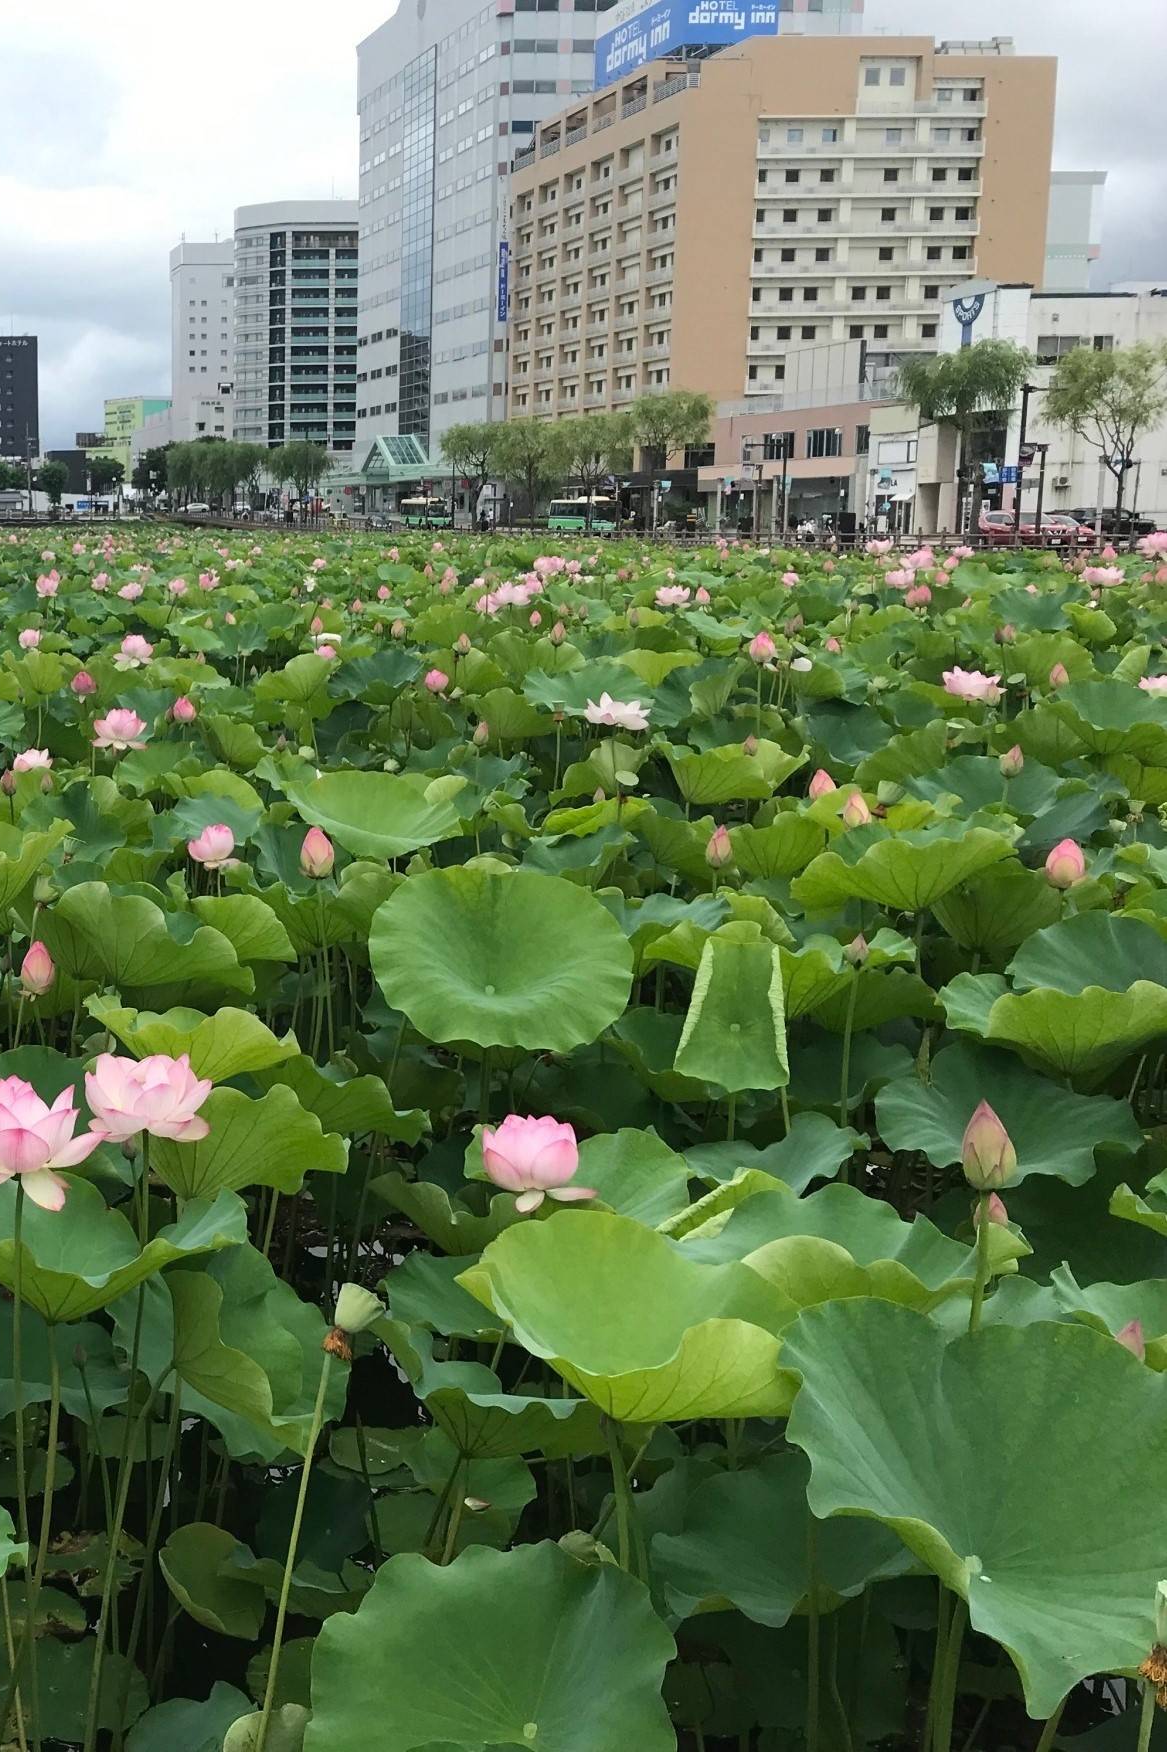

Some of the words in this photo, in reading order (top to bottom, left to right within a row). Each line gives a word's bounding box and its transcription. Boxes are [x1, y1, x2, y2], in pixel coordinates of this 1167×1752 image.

[701, 0, 739, 11] HOTEL
[688, 6, 745, 30] dormy
[751, 11, 775, 24] inn
[615, 21, 643, 45] HOTEL
[606, 33, 648, 73] dormy
[650, 20, 670, 48] inn
